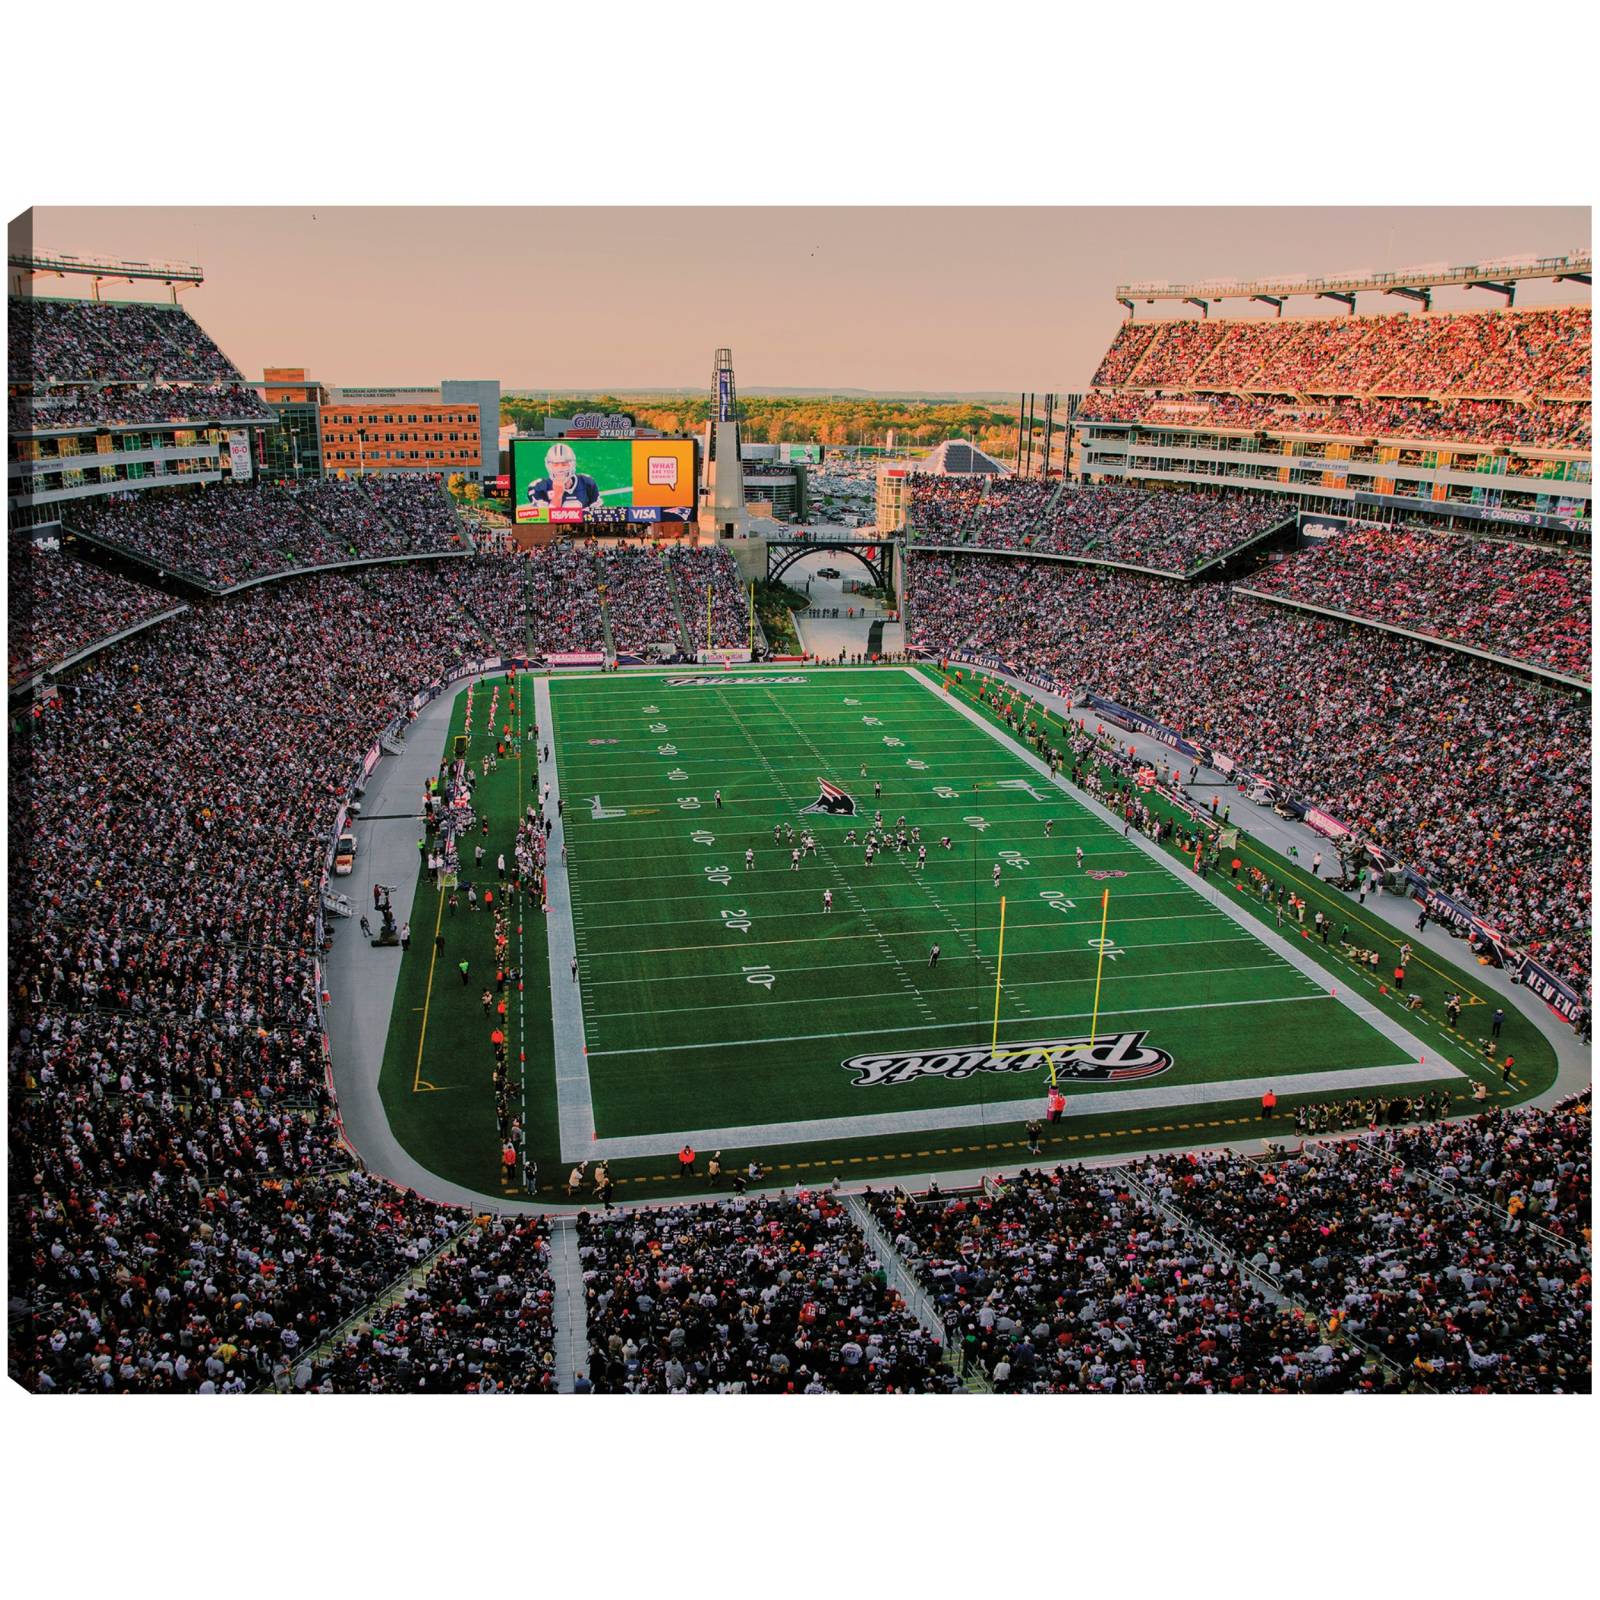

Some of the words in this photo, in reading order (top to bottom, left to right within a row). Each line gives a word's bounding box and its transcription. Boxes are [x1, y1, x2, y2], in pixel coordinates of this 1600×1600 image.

[574, 415, 630, 429] Gillette
[600, 429, 636, 437] STADIUM
[231, 446, 248, 454] 16-0
[632, 509, 657, 519] VISA
[1491, 510, 1530, 523] COWBOYS
[949, 654, 967, 662] NEW
[969, 655, 1000, 669] ENGLAND
[690, 829, 715, 844] 40
[998, 851, 1030, 867] 30
[704, 865, 732, 883] 30
[1039, 891, 1076, 911] 20
[720, 909, 752, 930] 20
[1088, 938, 1126, 955] 10
[742, 964, 775, 985] 10
[1526, 970, 1556, 1005] NEW
[842, 1031, 1172, 1086] Patriots
